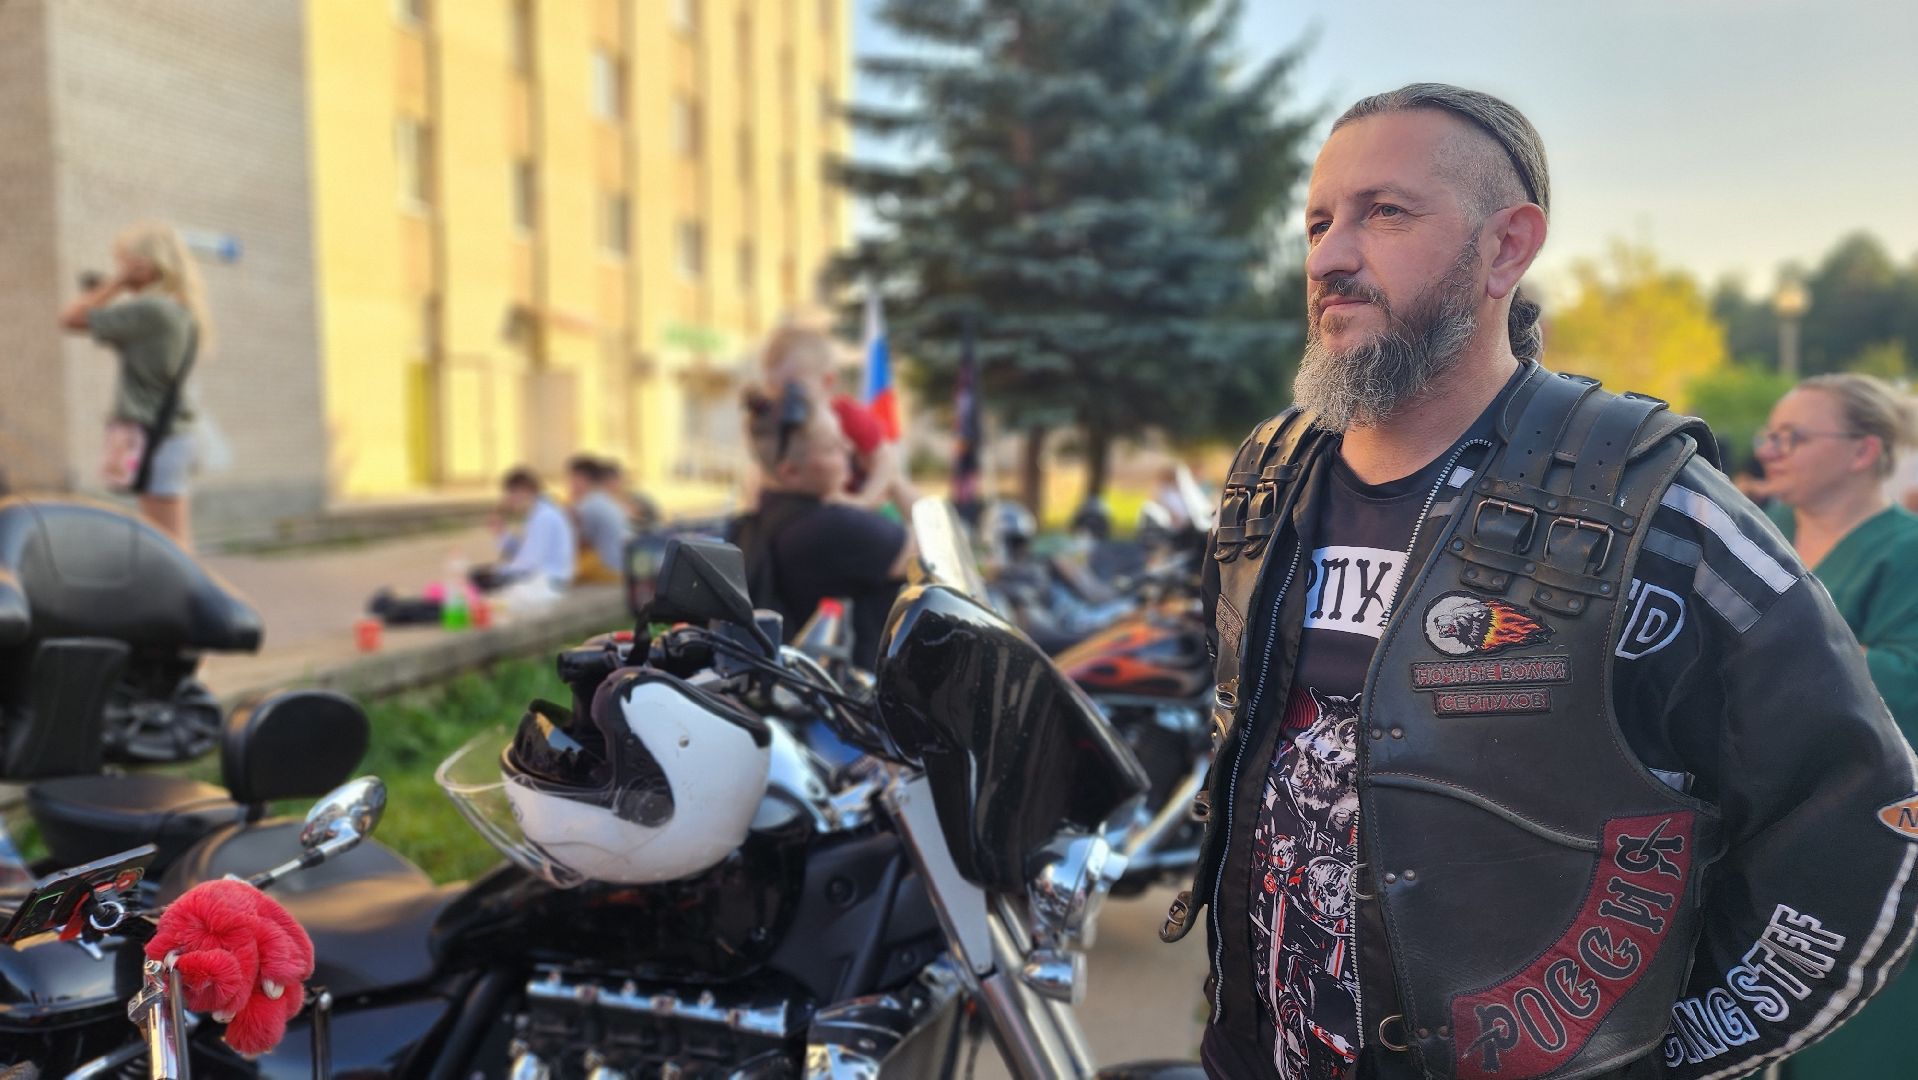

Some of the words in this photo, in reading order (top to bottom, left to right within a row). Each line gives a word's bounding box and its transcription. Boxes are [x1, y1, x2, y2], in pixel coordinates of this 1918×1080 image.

[1615, 577, 1687, 660] D
[1415, 662, 1497, 686] НОЧНЫЕ
[1500, 660, 1566, 681] ВОЛКИ
[1440, 691, 1546, 712] СЕРПУХОВ
[1459, 817, 1686, 1074] РОССИЯ
